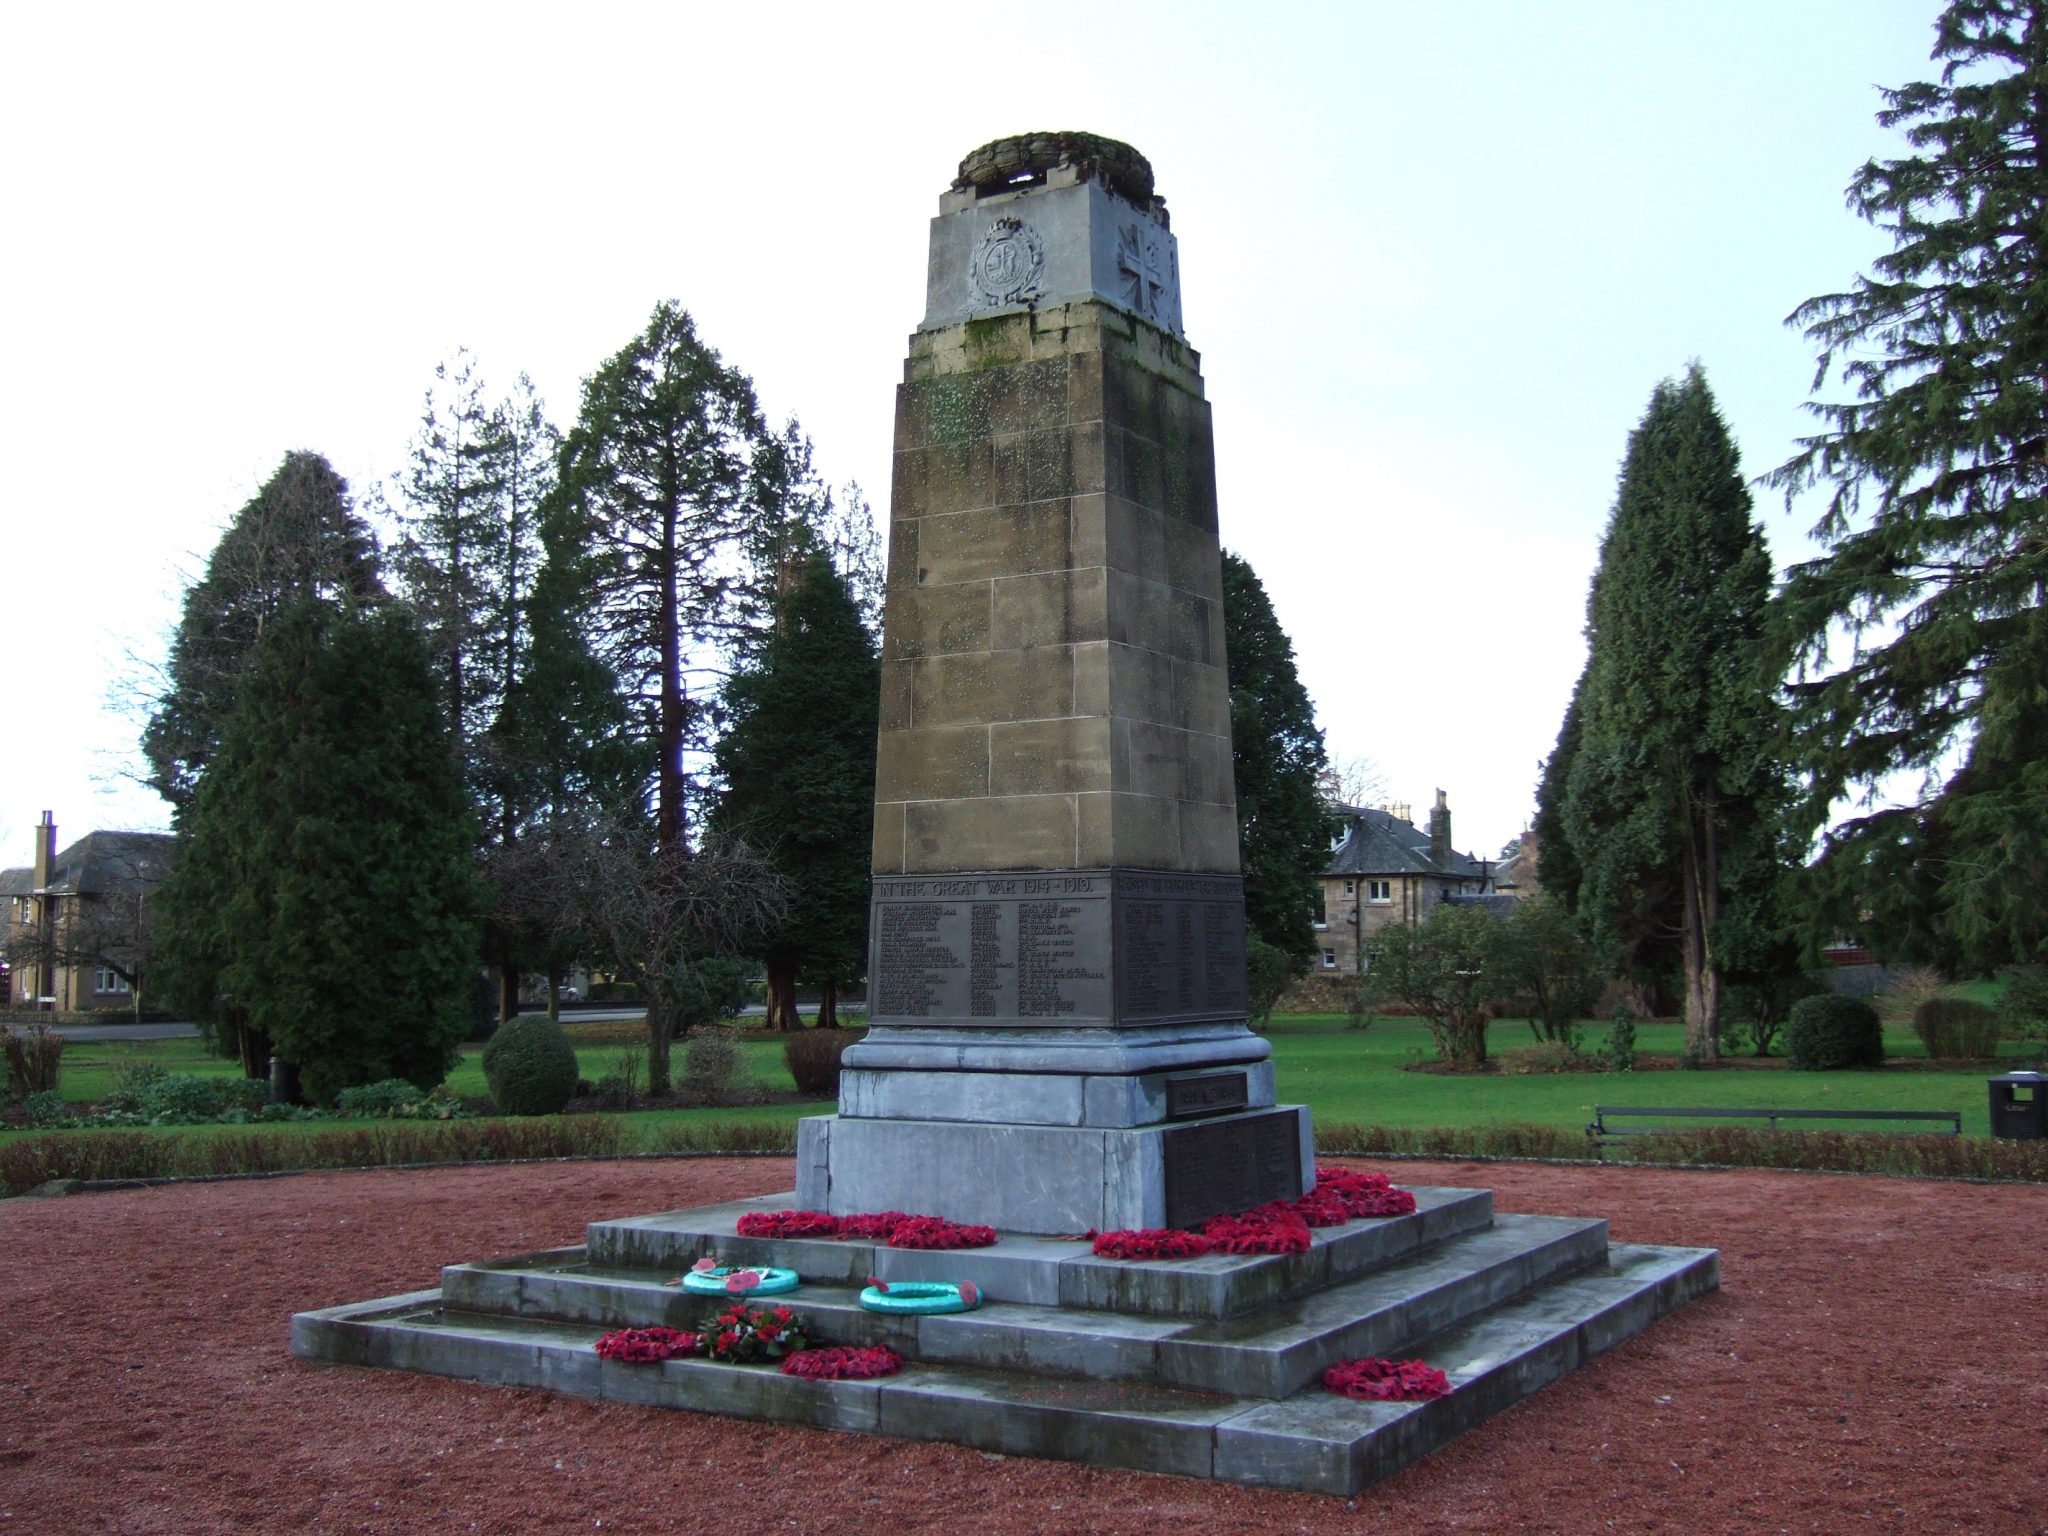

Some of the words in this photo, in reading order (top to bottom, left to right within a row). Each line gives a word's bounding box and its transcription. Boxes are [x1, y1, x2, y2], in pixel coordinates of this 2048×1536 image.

[880, 883, 893, 896] IN
[896, 882, 924, 896] THE
[931, 881, 980, 896] GREAT
[986, 880, 1016, 895] WAR
[1024, 879, 1050, 893] 1914
[1119, 877, 1148, 892] RAISED
[1153, 878, 1162, 893] IN
[1166, 879, 1196, 895] HUMBLE
[1200, 881, 1244, 897] GRATITUDE
